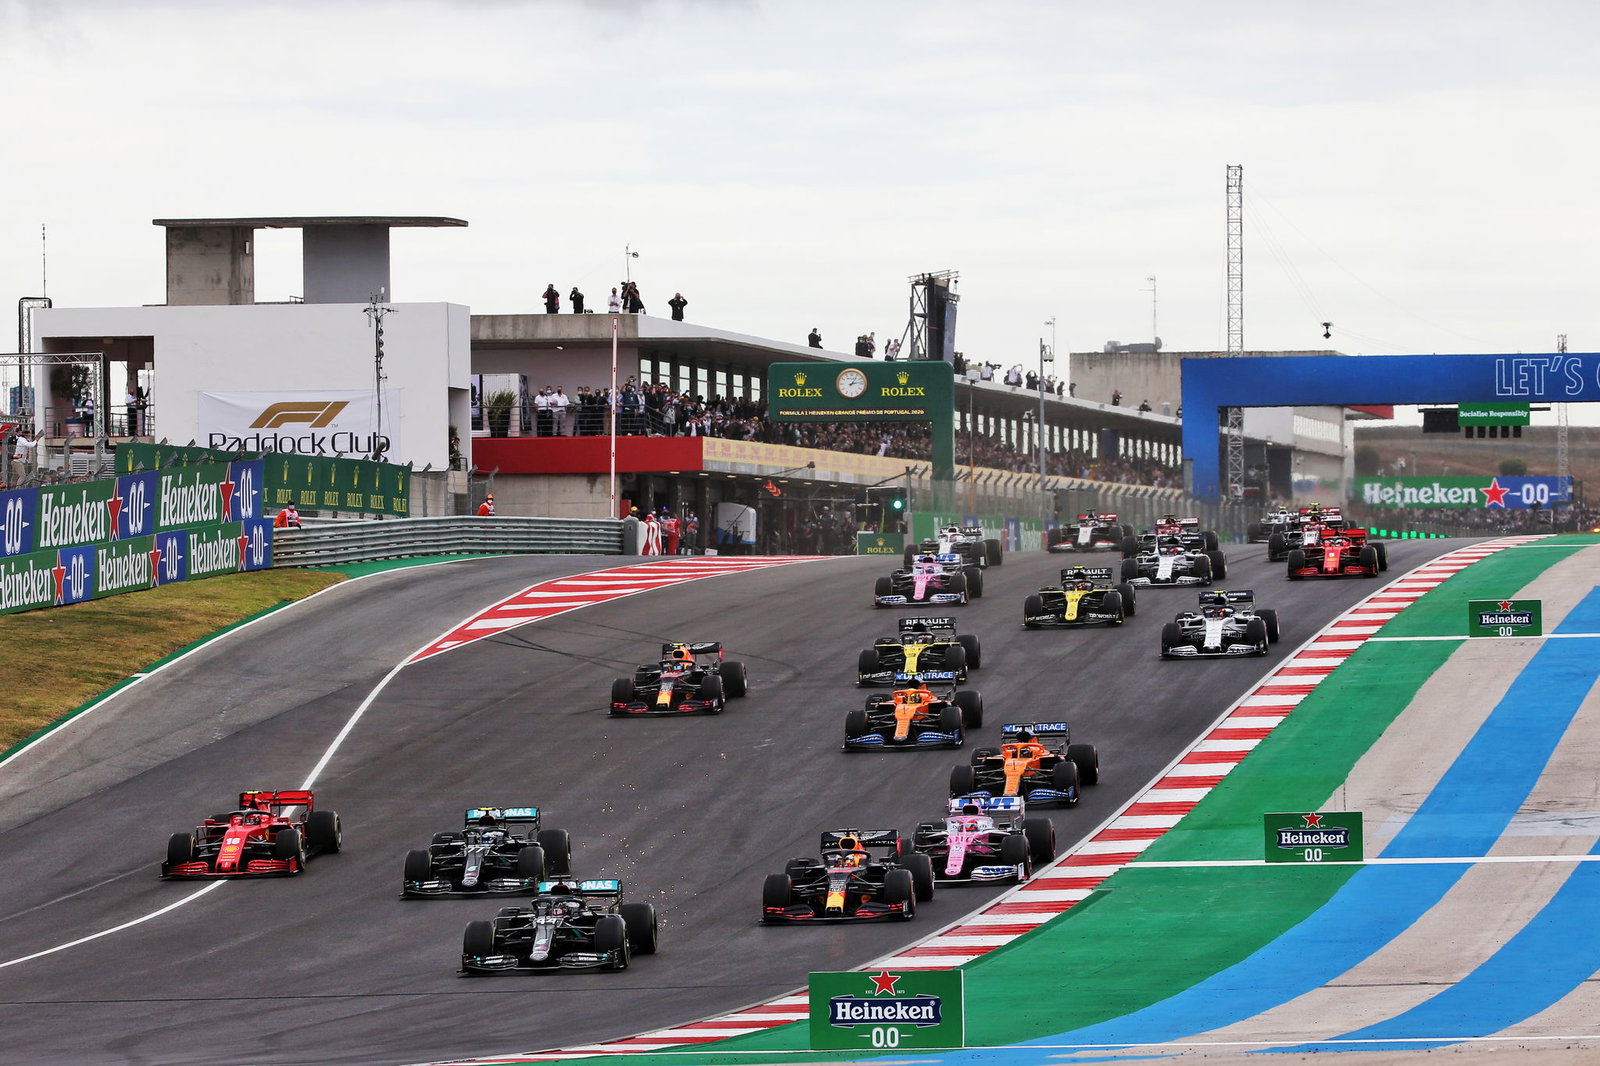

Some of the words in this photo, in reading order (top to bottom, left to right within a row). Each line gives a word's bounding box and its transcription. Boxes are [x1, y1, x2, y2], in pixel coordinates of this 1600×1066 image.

[778, 388, 822, 397] ROLEX
[881, 387, 925, 397] ROLEX
[1489, 410, 1528, 418] Responsibly
[209, 432, 326, 454] Paddock
[331, 431, 391, 454] Club
[160, 472, 217, 527] Heineken
[1363, 482, 1478, 504] Heineken
[40, 490, 105, 547] Heineken
[98, 544, 148, 592] Heineken
[189, 530, 236, 575] Heineken
[1481, 614, 1529, 624] Heineken
[1281, 832, 1345, 844] Heineken
[1304, 848, 1322, 861] 0.0
[836, 1001, 935, 1020] Heineken
[872, 1027, 899, 1048] 0.0
